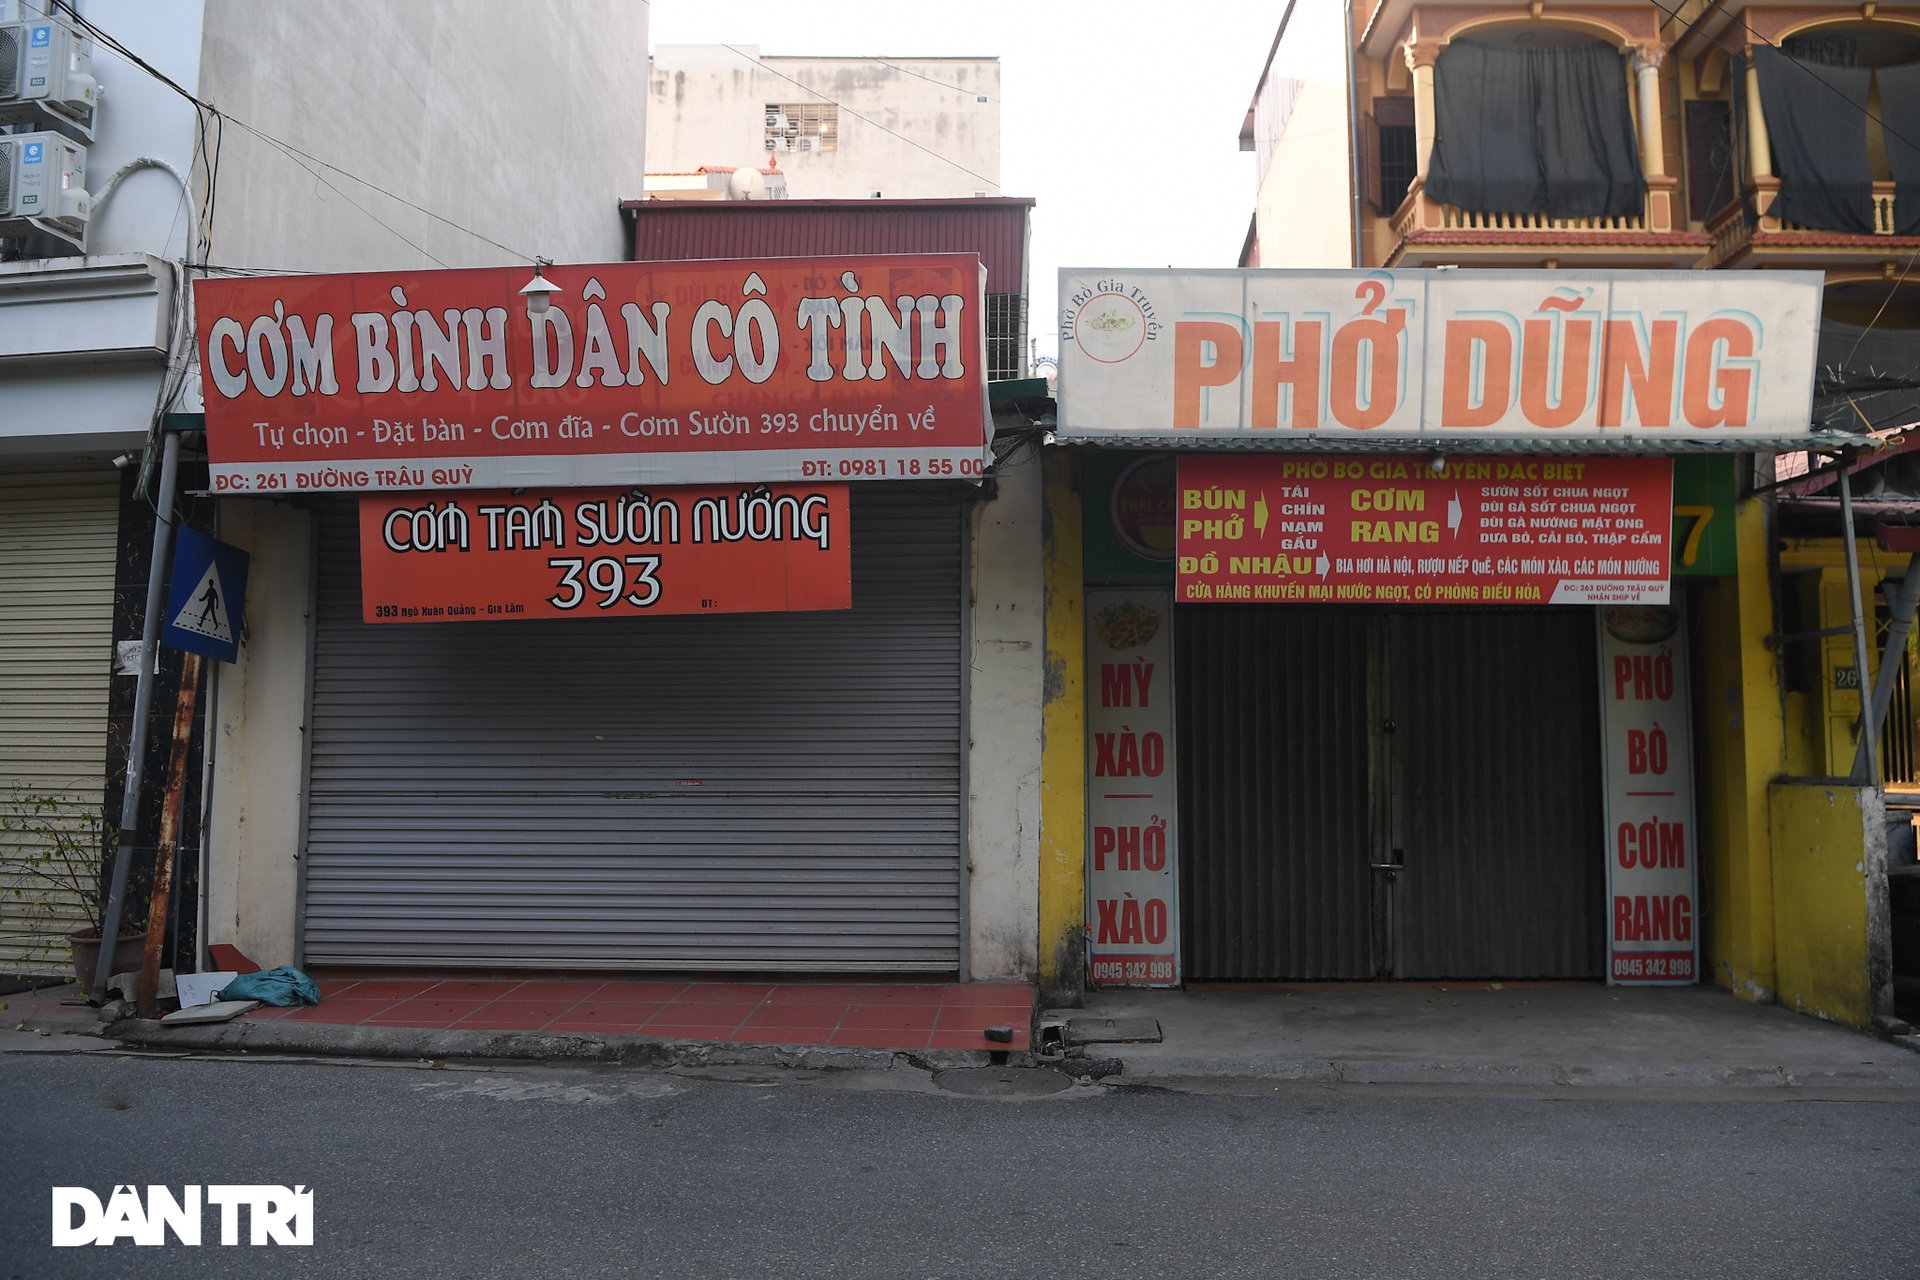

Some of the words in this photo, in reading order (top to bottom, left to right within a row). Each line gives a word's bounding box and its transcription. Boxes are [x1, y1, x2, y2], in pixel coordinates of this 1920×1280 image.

[1061, 308, 1076, 341] Phở
[1071, 286, 1093, 308] Bò
[1097, 279, 1124, 293] Gia
[1130, 286, 1163, 341] Truyền
[208, 299, 340, 399] CƠM
[351, 285, 512, 394] BÌNH
[527, 277, 670, 390] DÂN
[691, 272, 780, 385] CÔ
[1173, 278, 1408, 430] PHỞ
[1441, 293, 1756, 428] DŨNG
[253, 422, 285, 450] Tự
[292, 422, 349, 449] chọn
[372, 419, 415, 448] Đặt
[423, 418, 466, 441] bàn
[491, 416, 549, 440] Cơm
[558, 414, 593, 438] đĩa
[620, 412, 679, 437] Cơm
[689, 410, 750, 436] Sườn
[760, 413, 799, 433] 393
[809, 404, 897, 436] chuyển
[907, 404, 936, 430] về
[215, 473, 251, 491] ĐC:
[256, 473, 288, 490] 261
[295, 466, 370, 489] ĐƯỜNG
[375, 466, 425, 487] TRÂU
[430, 463, 474, 485] QUỲ
[801, 460, 833, 477] ĐT:
[839, 460, 886, 476] 0981
[898, 459, 921, 475] 18
[928, 459, 953, 475] 55
[960, 459, 983, 476] 00
[1369, 462, 1408, 479] GIA
[1183, 485, 1246, 509] BÚN
[1281, 486, 1310, 498] TÁI
[1351, 487, 1425, 511] CƠM
[1481, 486, 1519, 497] SƯỜN
[1523, 485, 1549, 497] SỐT
[1553, 488, 1589, 497] CHUA
[1593, 488, 1629, 500] NGỌT
[383, 501, 470, 552] CƠM
[574, 486, 680, 547] SƯỜN
[1281, 502, 1325, 515] CHÍN
[1480, 501, 1504, 512] ĐÙI
[1508, 500, 1526, 512] GÀ
[1530, 500, 1556, 513] SỐT
[1560, 503, 1596, 513] CHUA
[1600, 503, 1636, 515] NGỌT
[1183, 513, 1245, 540] PHỞ
[1281, 521, 1324, 535] NẠM
[1351, 521, 1439, 543] RANG
[1480, 516, 1504, 528] ĐÙI
[1507, 516, 1526, 528] GÀ
[1530, 516, 1578, 528] NƯỚNG
[1582, 517, 1612, 531] MẬT
[1615, 518, 1644, 528] ONG
[1592, 532, 1627, 546] THẬP
[1179, 551, 1220, 574] ĐỒ
[1229, 553, 1312, 578] NHẬU
[1336, 558, 1353, 573] BIA
[1356, 557, 1374, 573] HƠI
[1376, 555, 1391, 573] HÀ
[1393, 556, 1415, 577] NỘI,
[1418, 557, 1445, 576] RƯỢU
[1448, 554, 1469, 574] NẾP
[1497, 556, 1518, 574] CÁC
[1521, 556, 1545, 574] MÓN
[1548, 557, 1571, 576] XÀO,
[1574, 556, 1595, 575] CÁC
[1597, 557, 1622, 575] MÓN
[1624, 557, 1660, 575] NƯỚNG
[548, 554, 662, 609] 393
[1186, 581, 1212, 599] CỬA
[1216, 582, 1251, 599] HÀNG
[1255, 581, 1305, 599] KHUYẾN
[1308, 585, 1332, 601] MẠI
[1337, 582, 1372, 599] NƯỚC
[1375, 586, 1410, 602] NGỌT,
[1415, 583, 1432, 599] CÓ
[1435, 583, 1479, 599] PHÒNG
[1515, 583, 1541, 599] HÒA
[375, 605, 398, 617] 393
[1101, 656, 1155, 708] MỲ
[1614, 644, 1674, 701] PHỞ
[1094, 726, 1165, 778] XÀO
[1627, 721, 1668, 775] BÒ
[1094, 814, 1168, 871] PHỞ
[1617, 816, 1685, 870] CƠM
[1096, 892, 1168, 945] XÀO
[1614, 895, 1691, 941] RANG
[1094, 962, 1122, 979] 0945
[1125, 962, 1147, 979] 342
[1150, 961, 1172, 979] 998
[1614, 959, 1643, 975] 0945
[1646, 959, 1666, 975] 342
[1669, 959, 1691, 975] 998
